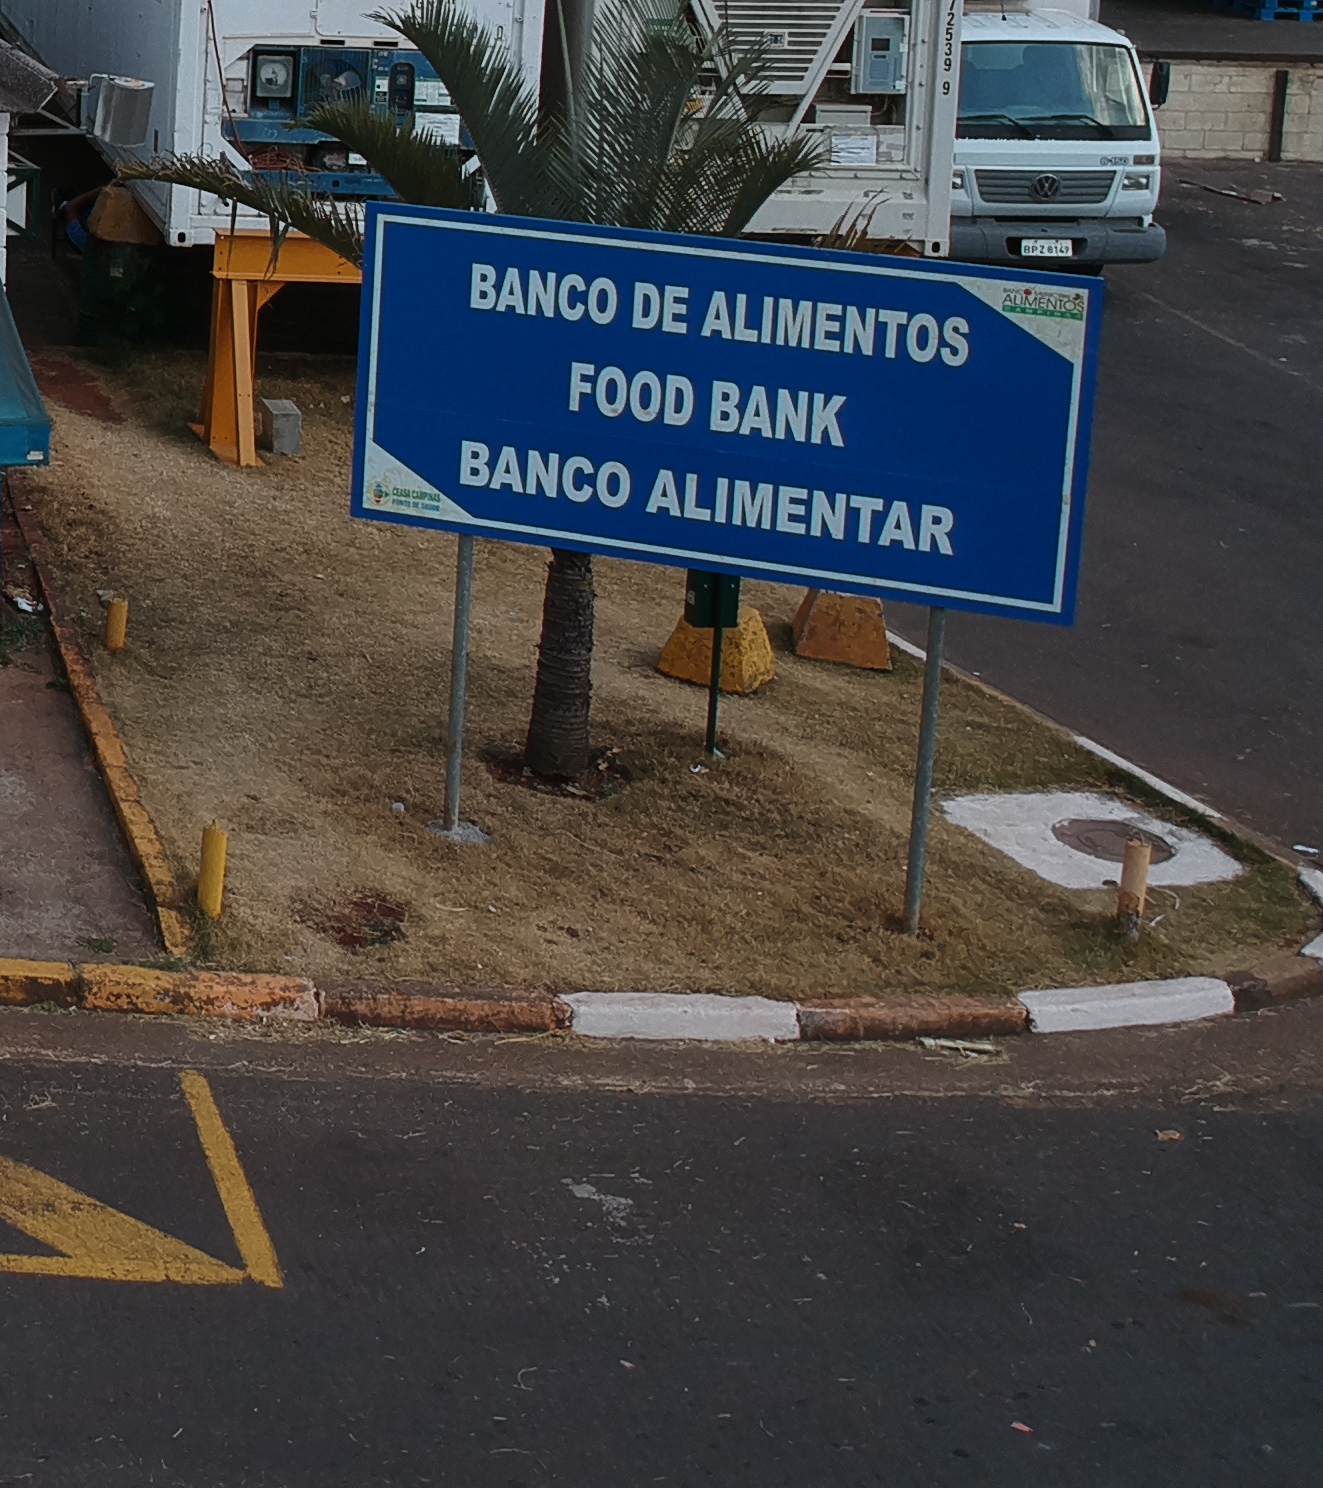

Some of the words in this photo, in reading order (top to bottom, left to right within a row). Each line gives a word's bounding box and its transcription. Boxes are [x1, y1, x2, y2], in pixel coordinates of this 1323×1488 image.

[470, 263, 618, 325] BANCO
[632, 281, 689, 334] DE
[700, 290, 970, 367] ALIMENTOS
[1002, 293, 1085, 313] ALIMENTOS
[569, 361, 694, 426] FOOD
[709, 380, 847, 448] BANK
[459, 440, 631, 509] BANCO
[645, 468, 955, 556] ALIMENTAR
